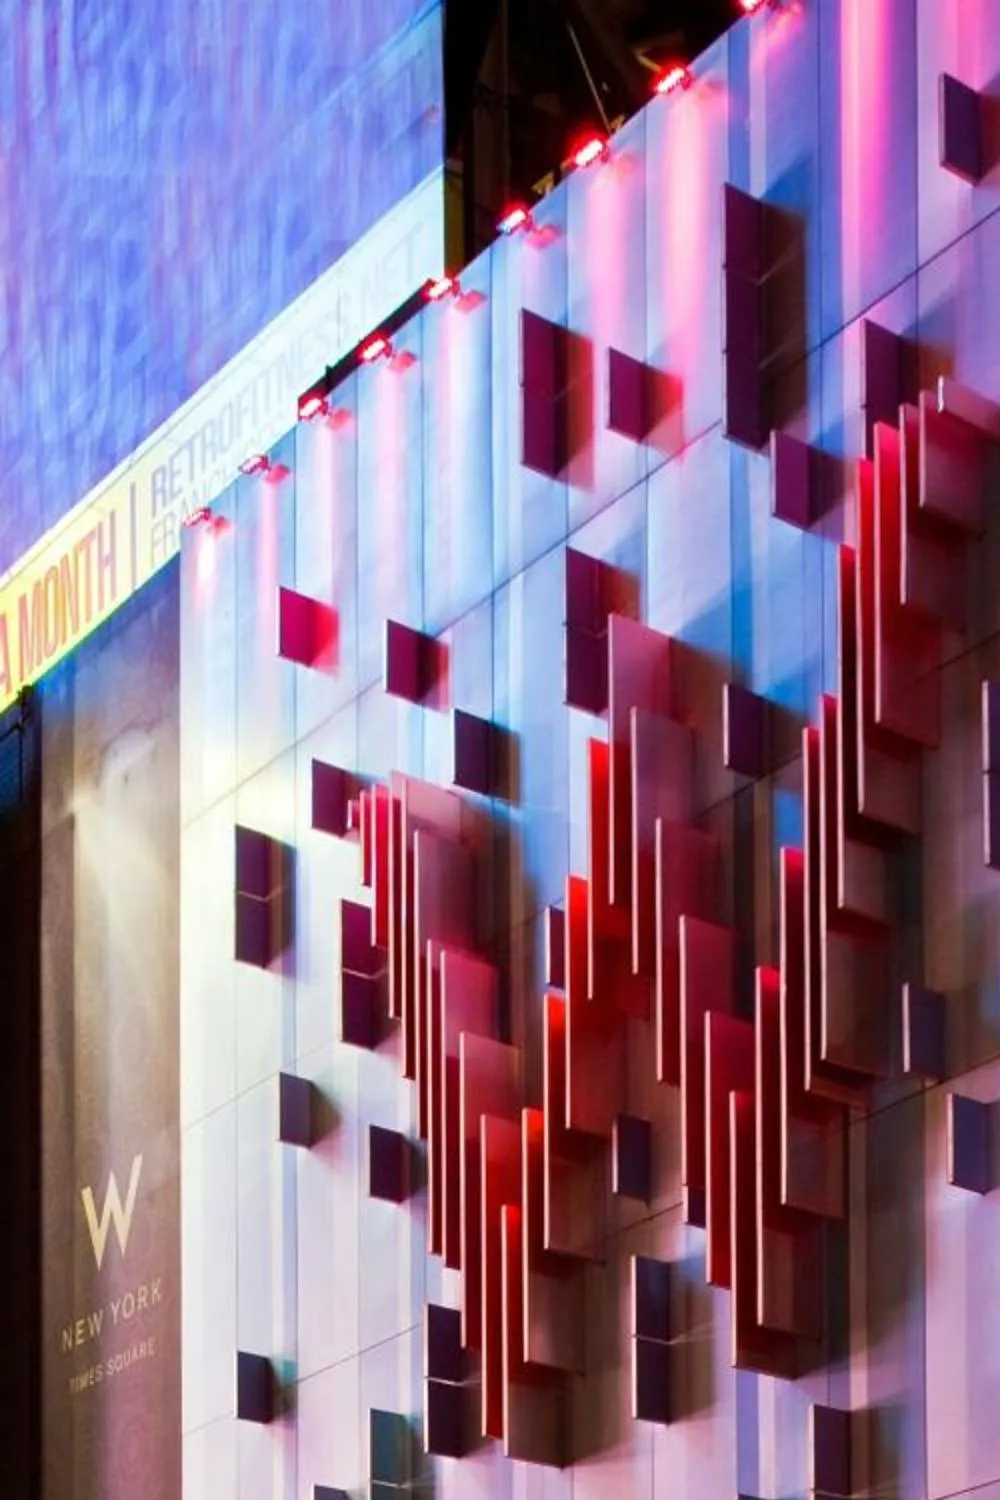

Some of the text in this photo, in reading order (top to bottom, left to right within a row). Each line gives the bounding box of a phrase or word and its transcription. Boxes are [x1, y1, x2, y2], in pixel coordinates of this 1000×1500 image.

[18, 509, 117, 682] MONTH
[81, 1154, 143, 1272] W
[62, 1278, 162, 1353] NEW YORK
[69, 1337, 157, 1394] TIMES SQUARE
